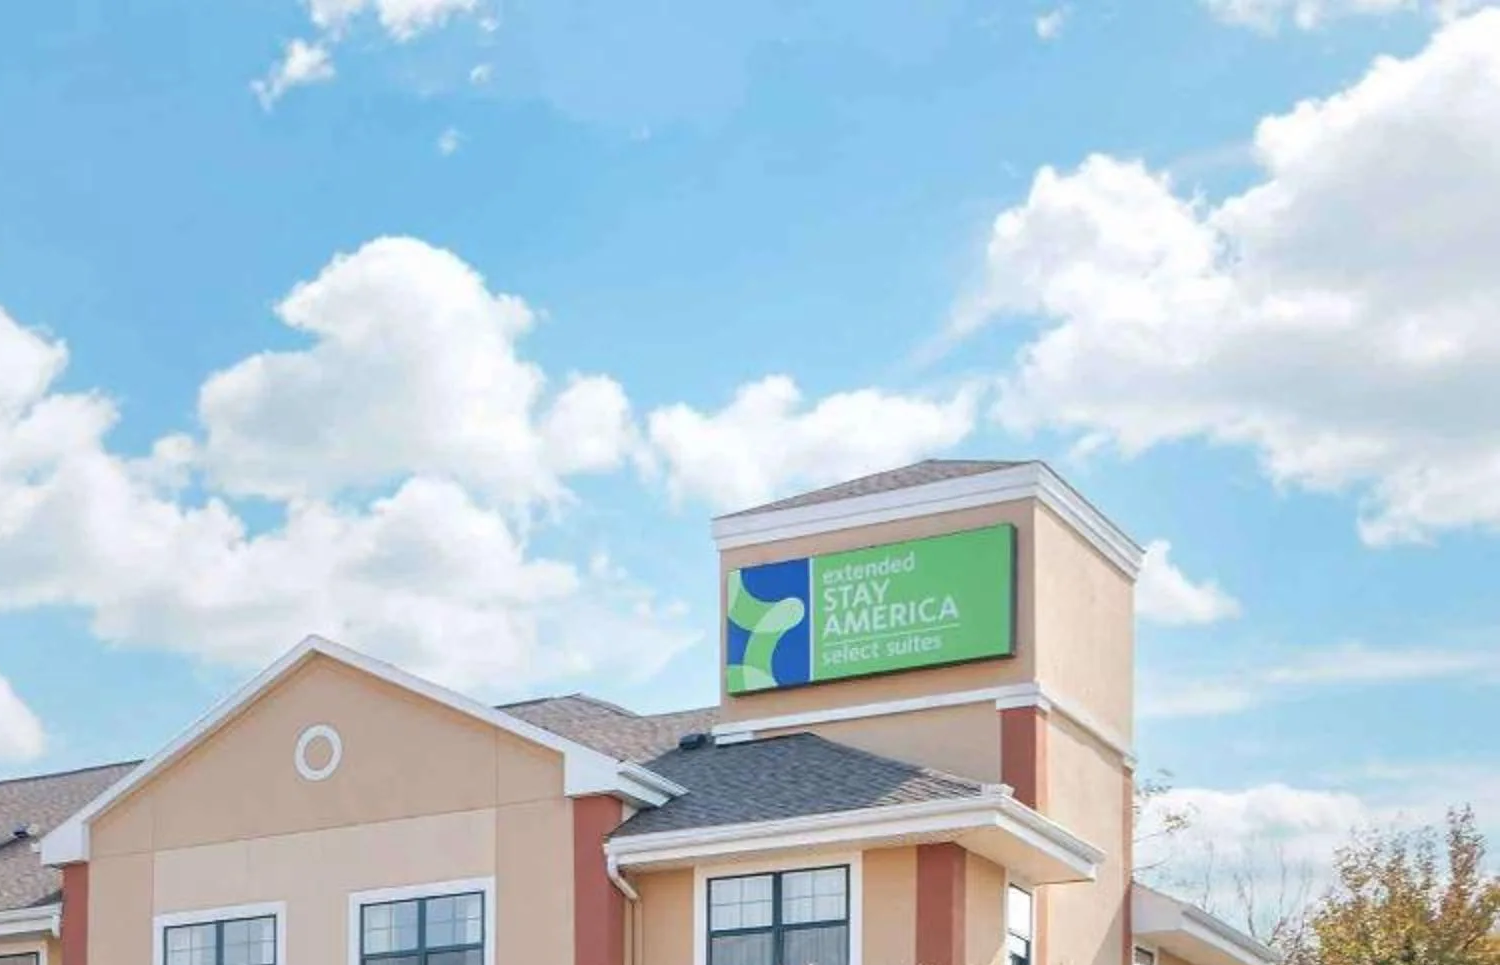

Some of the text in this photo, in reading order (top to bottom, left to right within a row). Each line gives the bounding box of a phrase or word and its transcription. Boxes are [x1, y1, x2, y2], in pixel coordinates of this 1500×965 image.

[822, 551, 915, 585] extended
[823, 577, 891, 613] STAY
[822, 593, 960, 639] AMERICA
[822, 634, 942, 666] select suites
